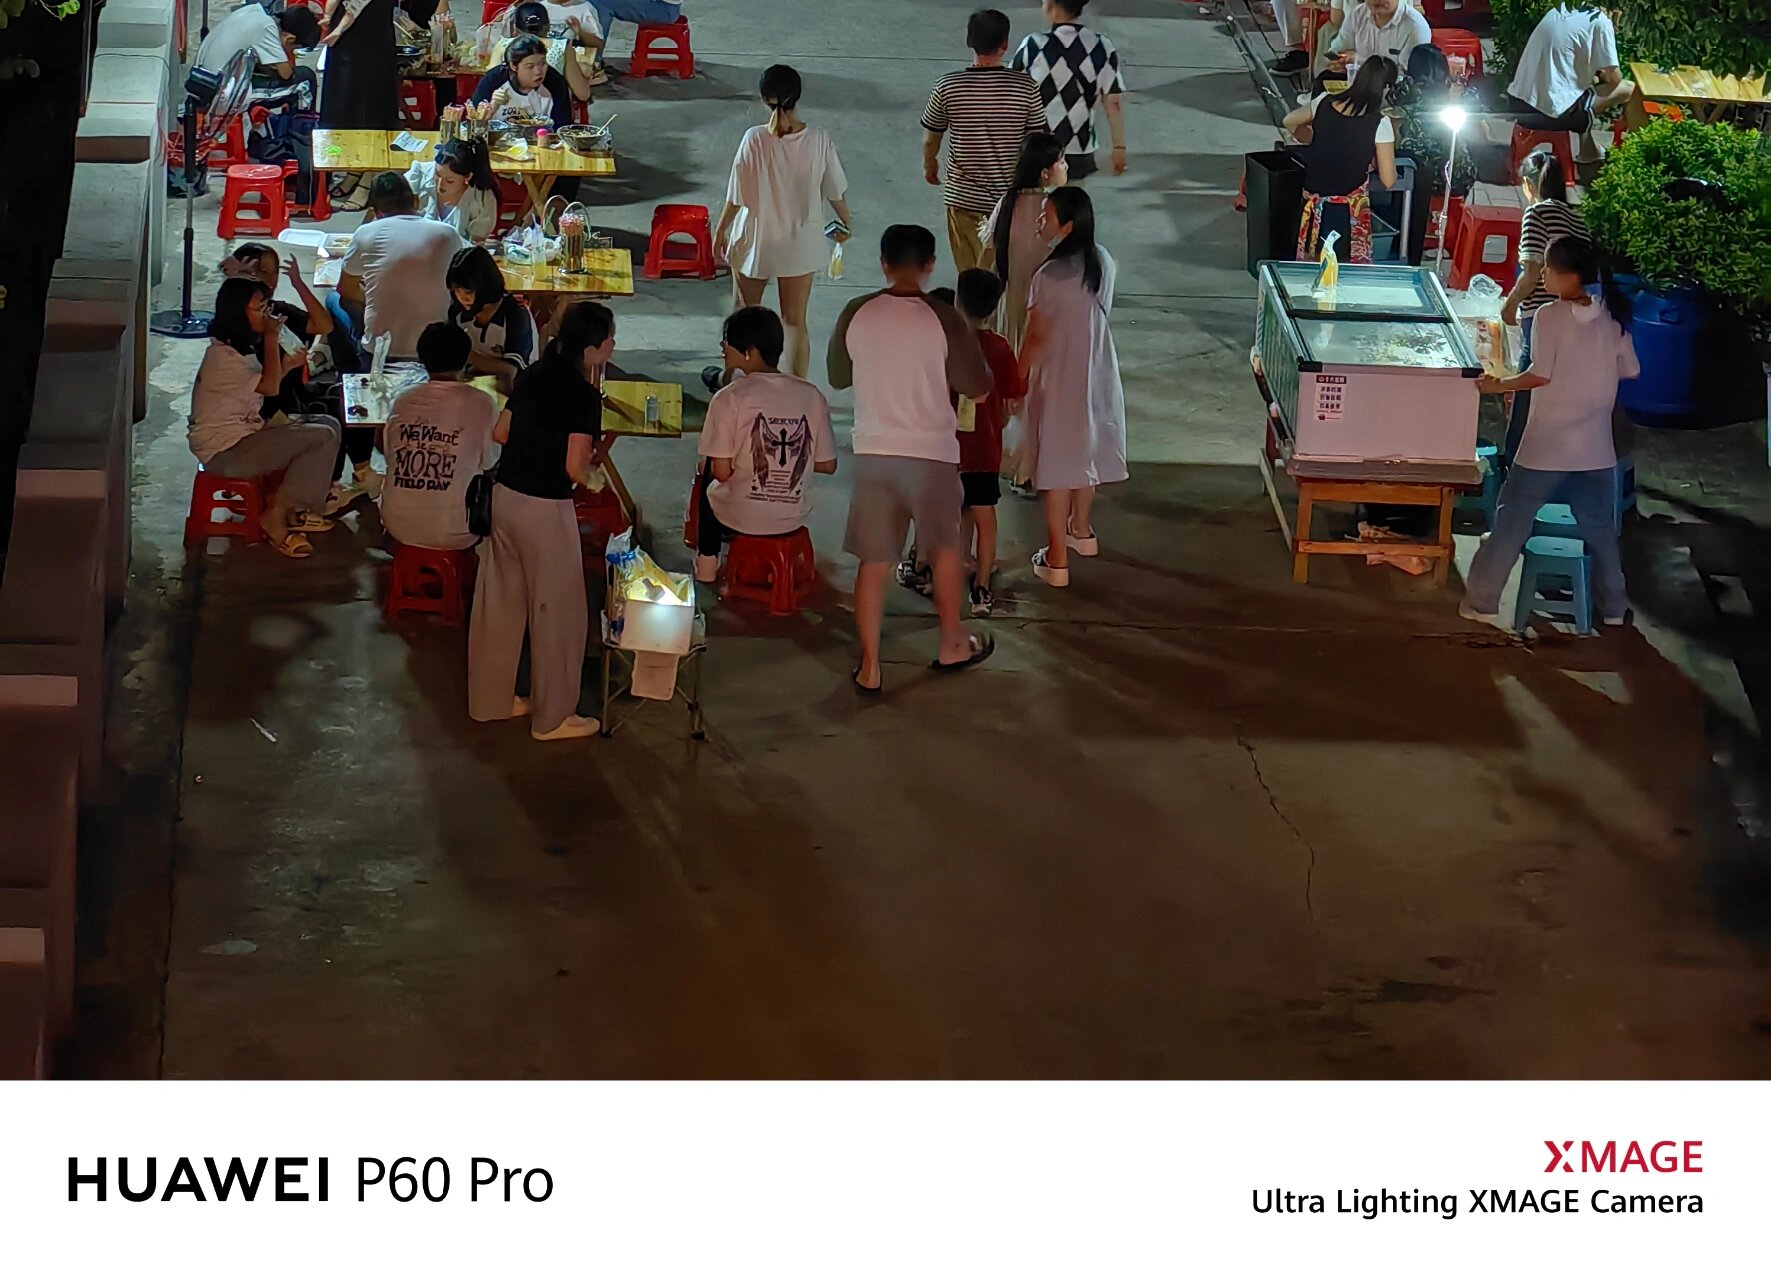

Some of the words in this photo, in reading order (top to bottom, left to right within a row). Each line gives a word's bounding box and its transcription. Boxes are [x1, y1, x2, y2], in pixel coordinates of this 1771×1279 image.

[421, 425, 460, 446] Want
[394, 448, 457, 480] MORE
[426, 479, 452, 492] DAY
